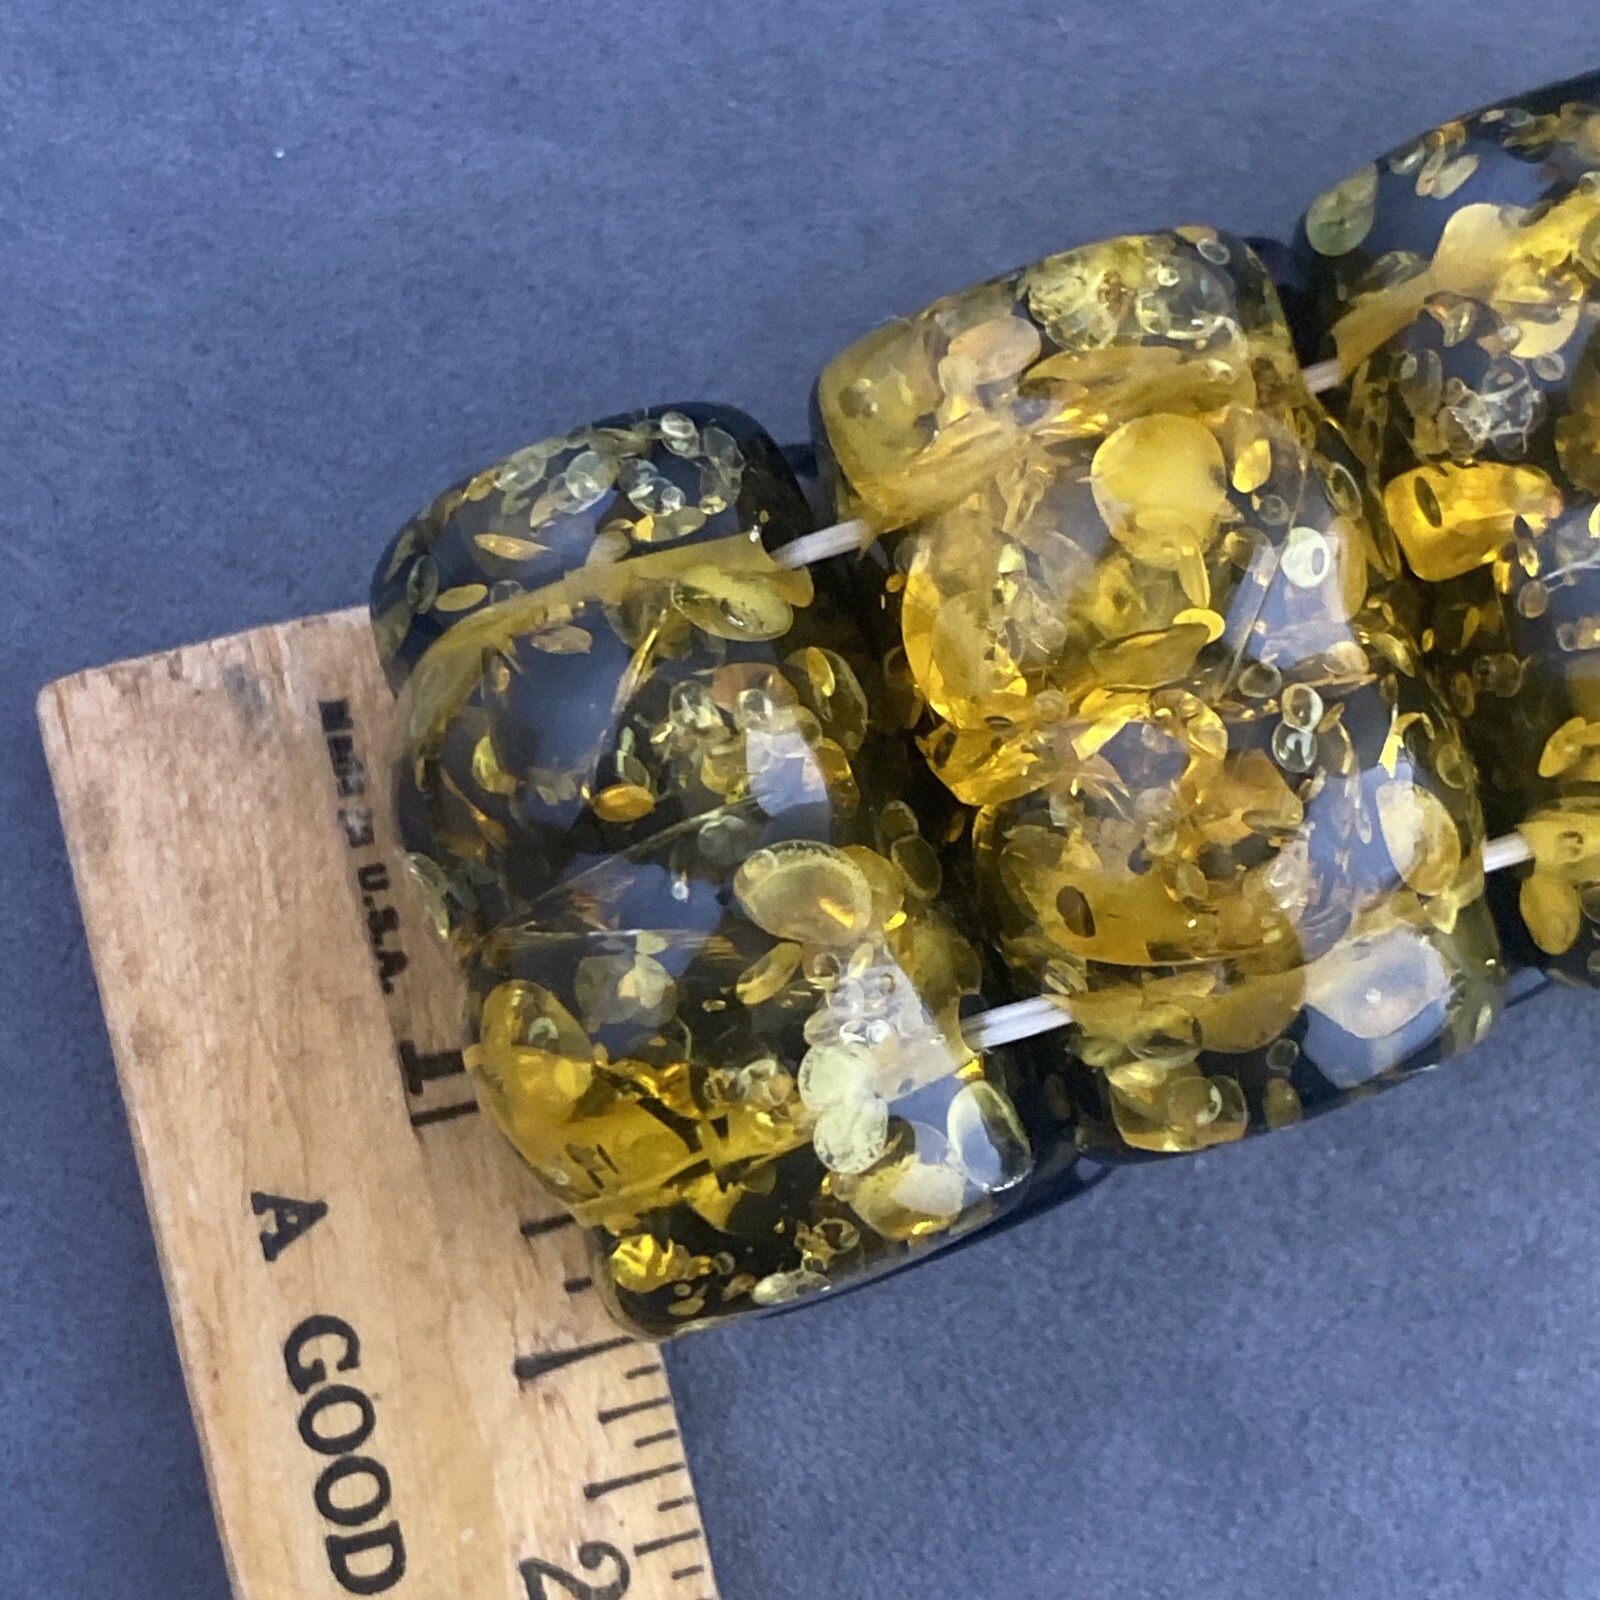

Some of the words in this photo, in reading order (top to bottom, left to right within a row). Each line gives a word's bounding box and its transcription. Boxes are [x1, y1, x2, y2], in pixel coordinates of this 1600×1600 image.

[358, 863, 408, 995] U.S.A.
[250, 1191, 328, 1262] A
[284, 1315, 407, 1596] GOOD
[519, 1541, 631, 1600] 2
